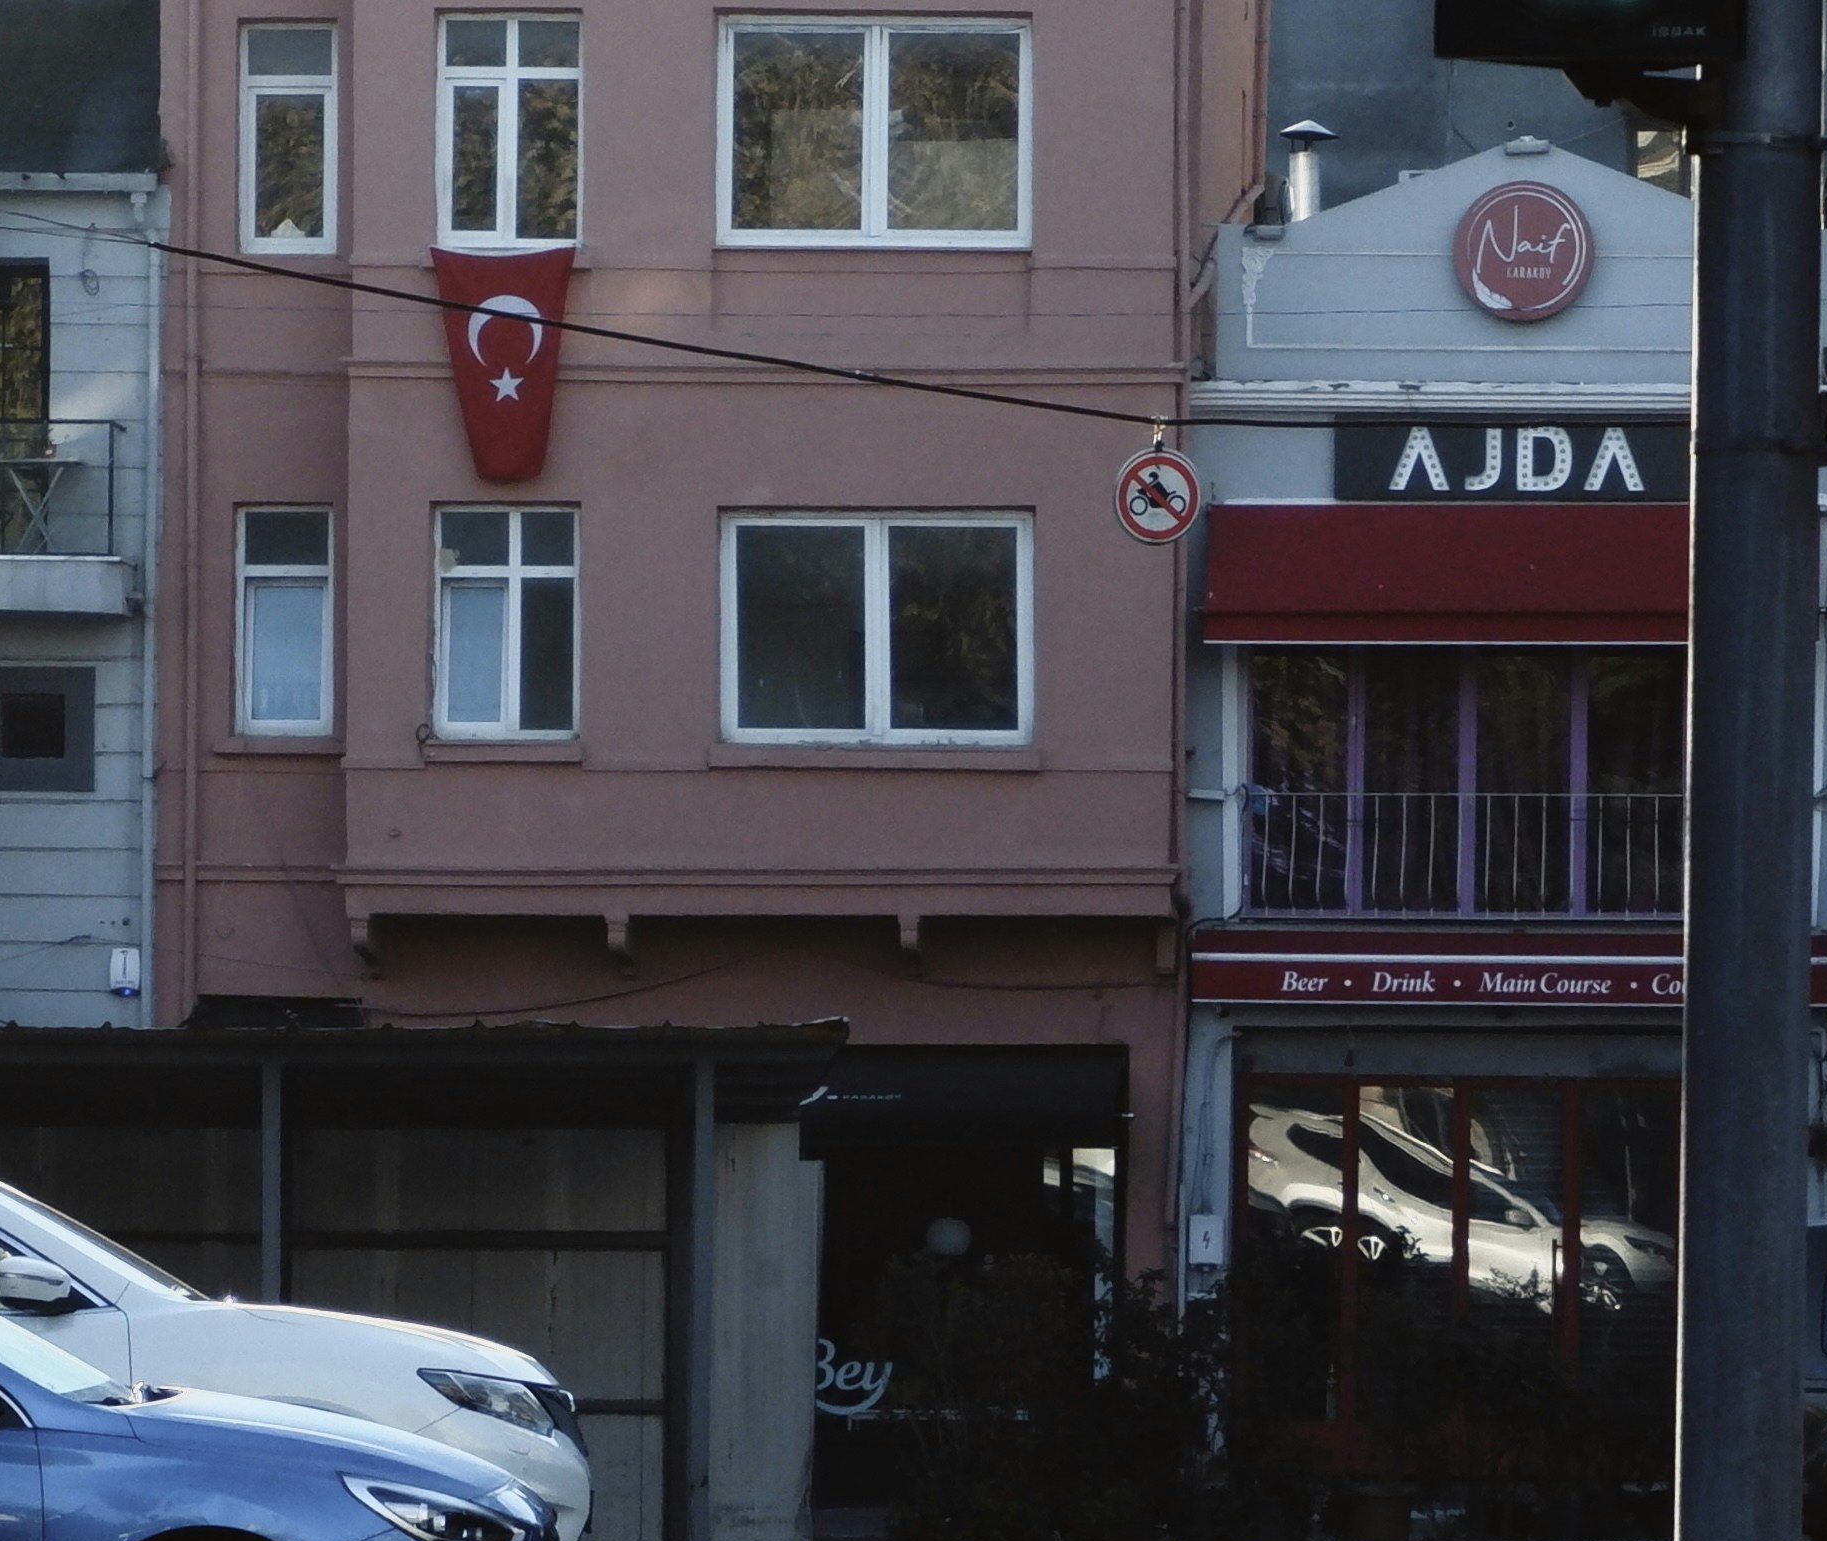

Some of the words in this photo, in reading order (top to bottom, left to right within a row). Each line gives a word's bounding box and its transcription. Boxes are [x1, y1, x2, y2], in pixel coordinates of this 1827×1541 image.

[1476, 204, 1572, 275] Naif
[1387, 426, 1646, 492] AJDA
[1281, 970, 1329, 993] Beer
[1371, 970, 1436, 994] Drink
[1479, 972, 1535, 994] Main
[1540, 972, 1612, 995] Course
